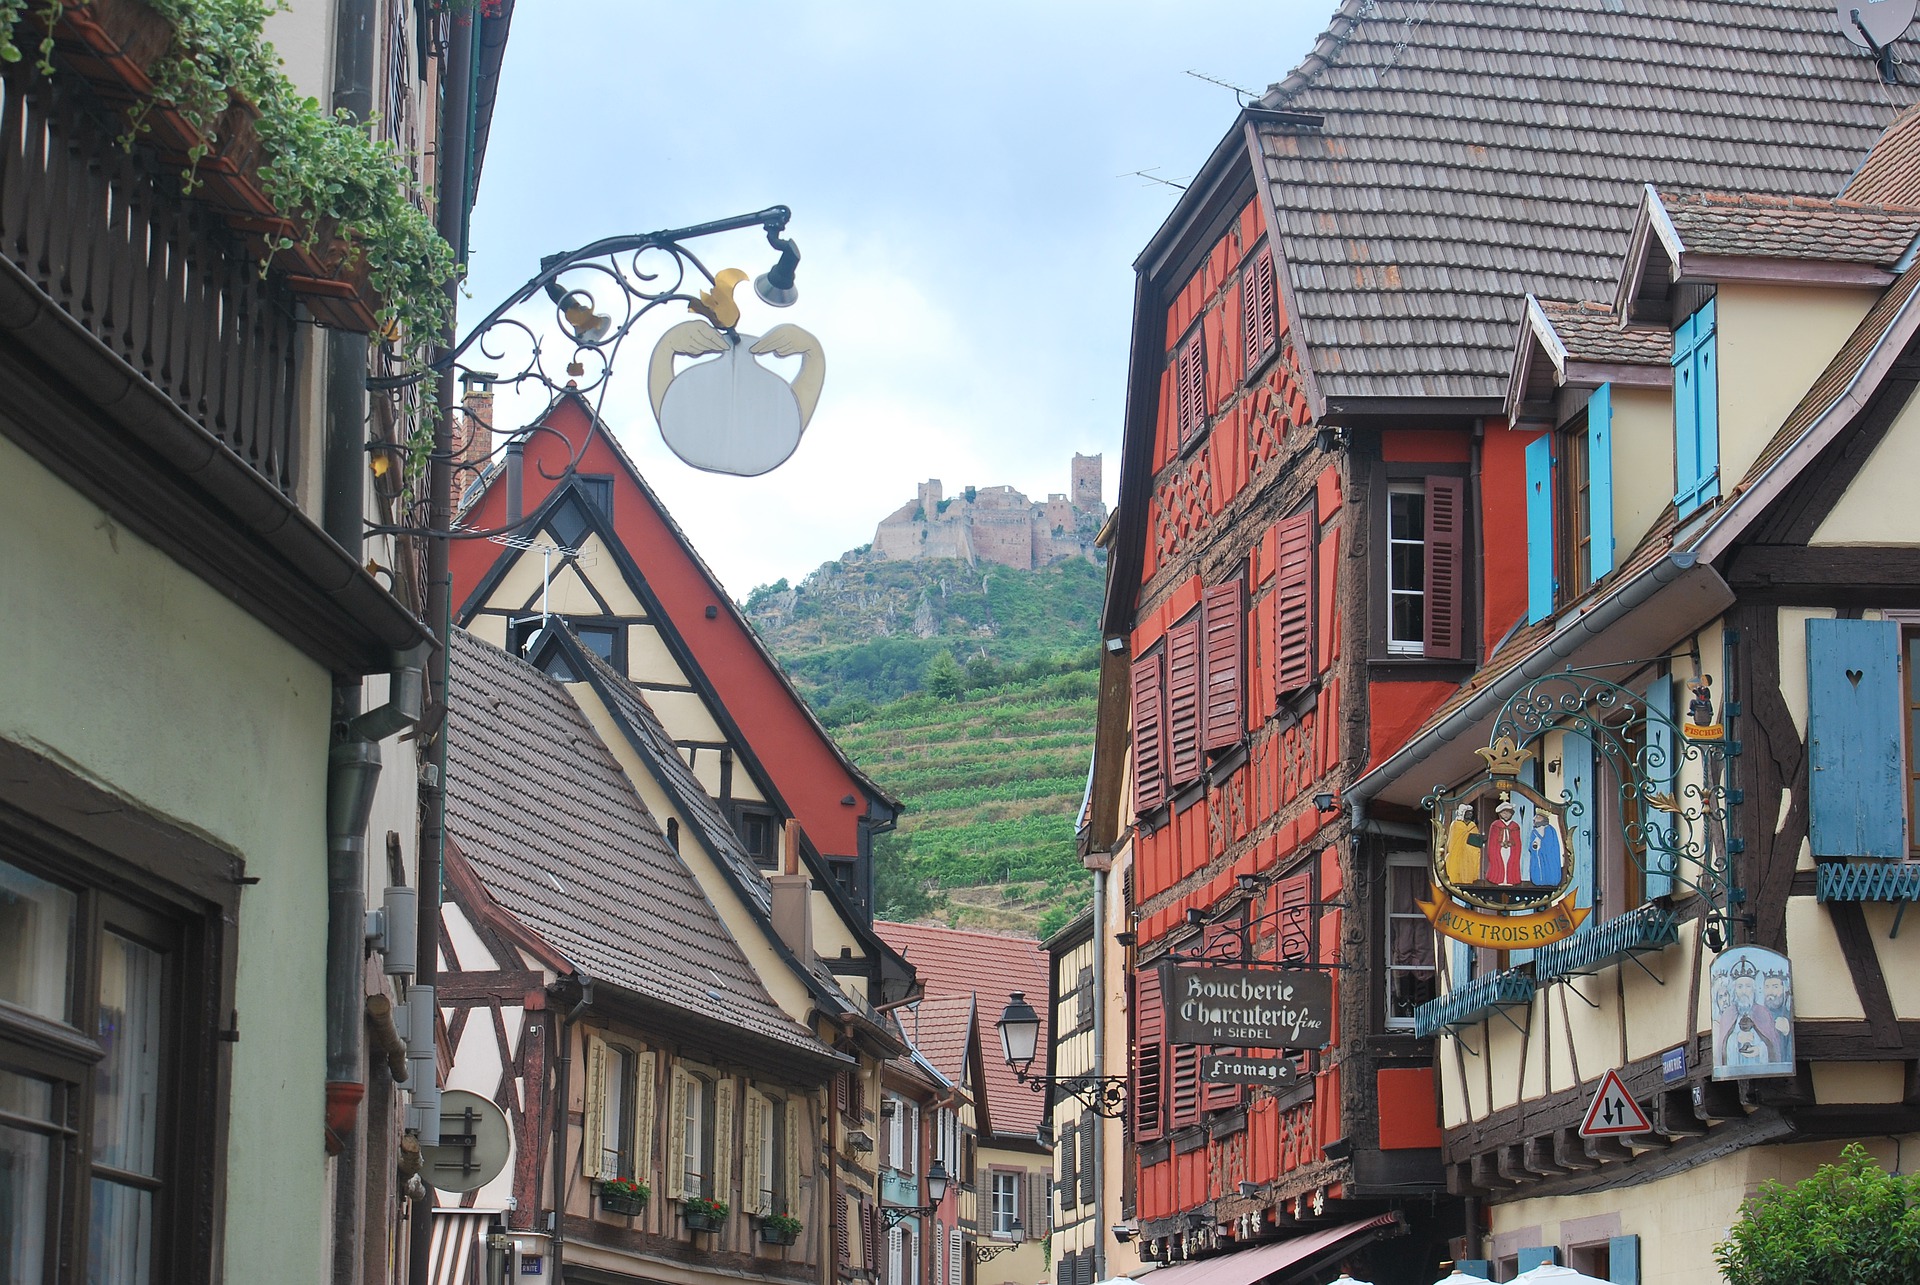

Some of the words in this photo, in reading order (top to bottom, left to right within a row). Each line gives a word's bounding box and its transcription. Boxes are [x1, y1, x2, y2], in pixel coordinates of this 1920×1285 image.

[1684, 726, 1723, 736] FISCHER
[1438, 910, 1475, 936] AUX
[1479, 923, 1530, 942] TROIS
[1532, 914, 1571, 940] ROIS
[1186, 974, 1294, 1002] Boucherie
[1180, 998, 1296, 1027] Charcuterie
[1290, 1007, 1322, 1042] fine
[1213, 1027, 1222, 1037] H
[1228, 1027, 1272, 1039] SIEDEL
[1210, 1059, 1288, 1080] Fromage
